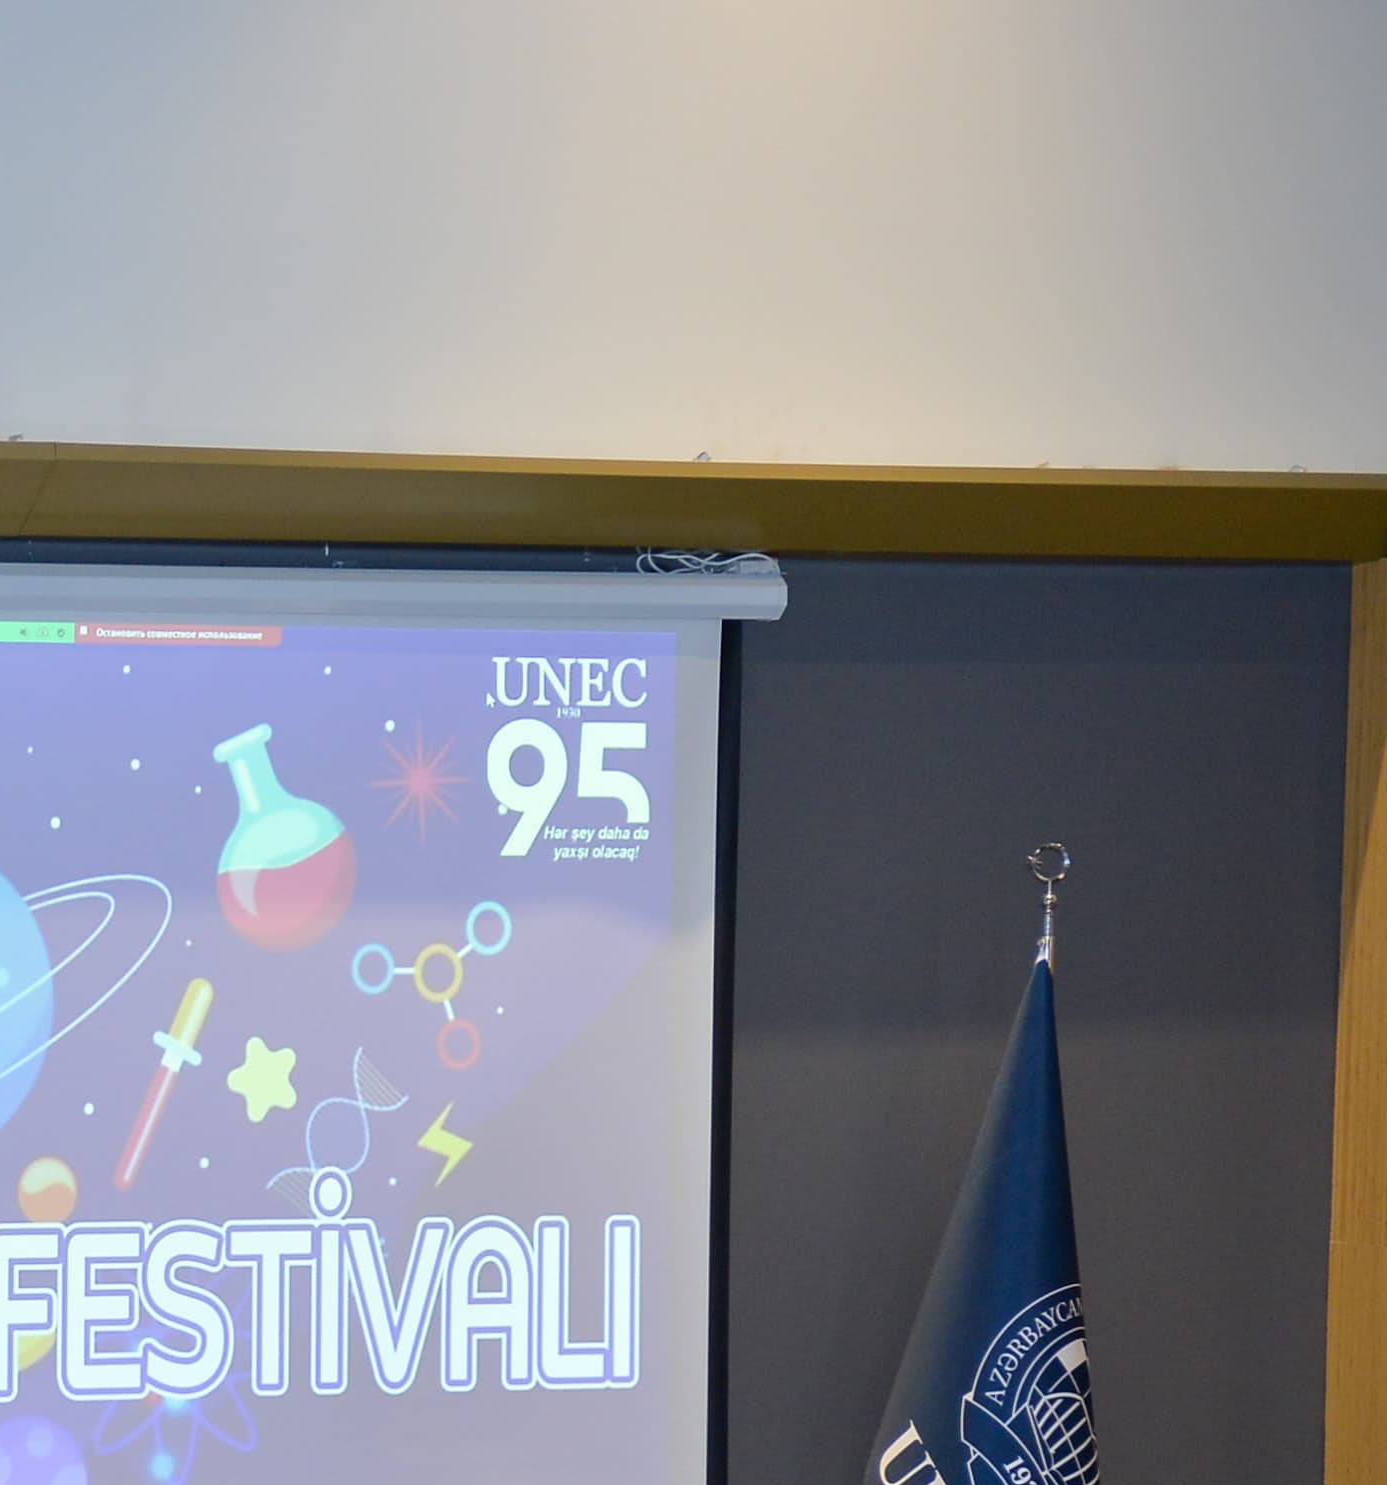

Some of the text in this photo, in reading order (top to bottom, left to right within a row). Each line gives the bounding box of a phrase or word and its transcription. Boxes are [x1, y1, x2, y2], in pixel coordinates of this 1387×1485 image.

[491, 656, 648, 708] UNEC
[486, 718, 651, 857] 95
[571, 827, 596, 843] şey
[598, 825, 631, 840] daha
[633, 826, 650, 840] da
[553, 844, 640, 862] yaxşı olacaq!
